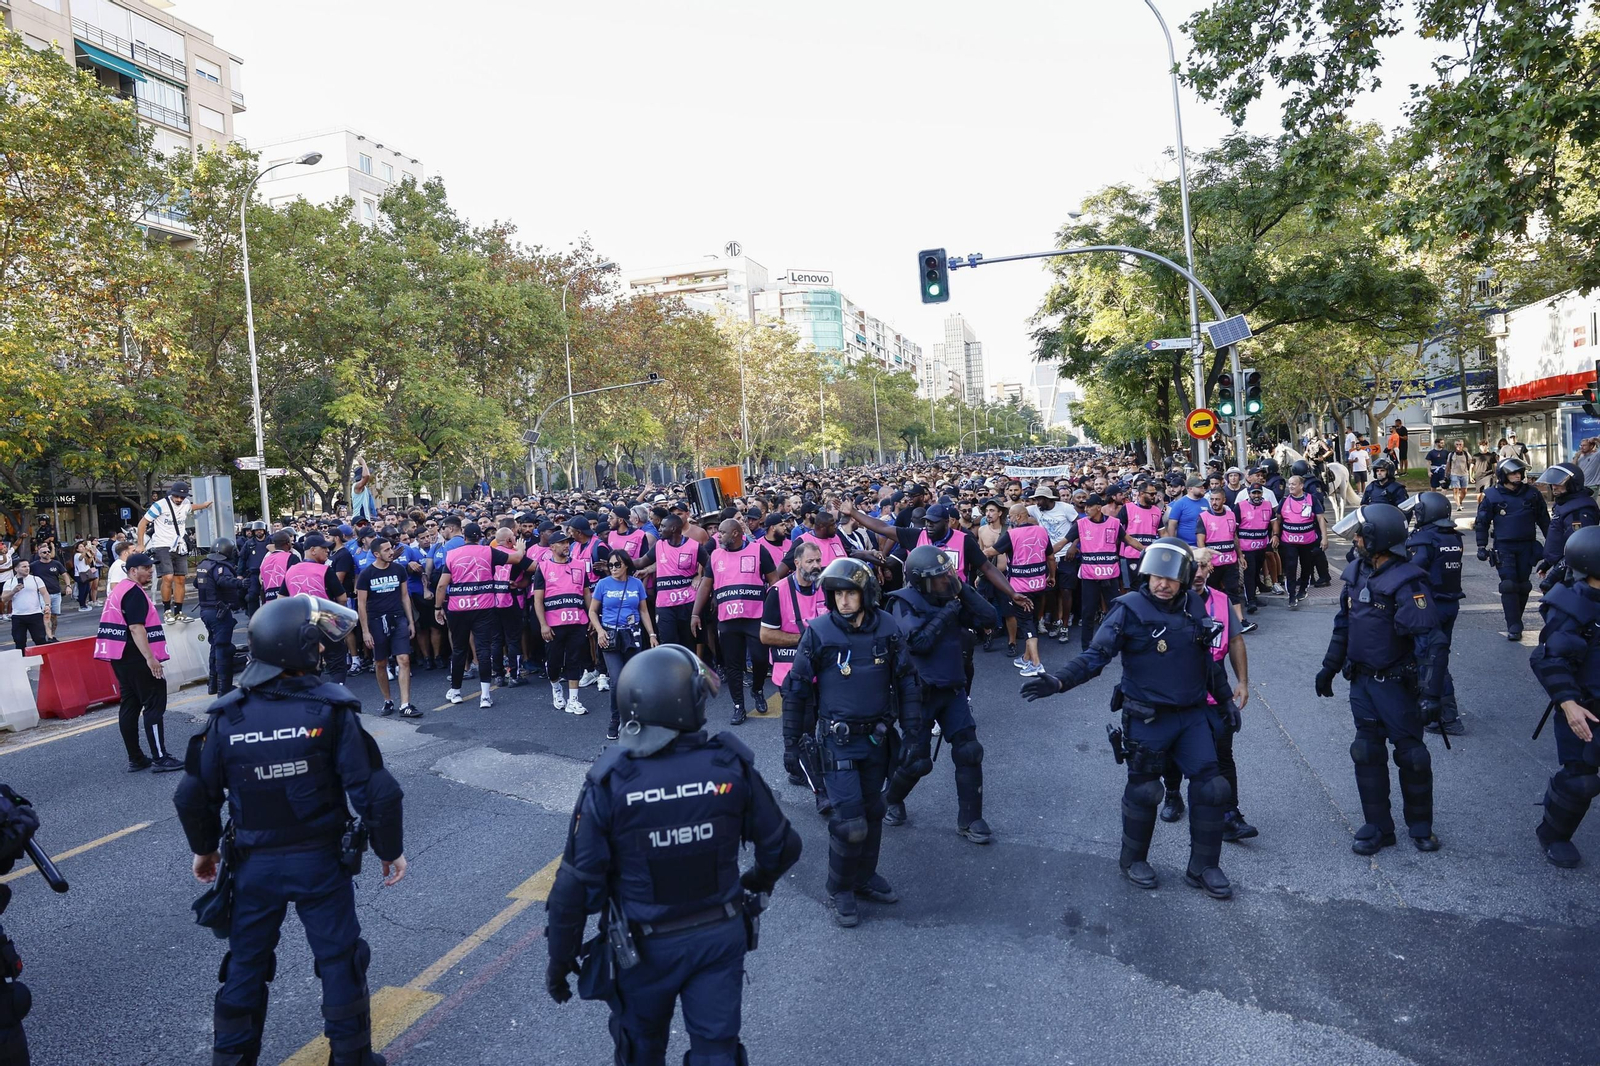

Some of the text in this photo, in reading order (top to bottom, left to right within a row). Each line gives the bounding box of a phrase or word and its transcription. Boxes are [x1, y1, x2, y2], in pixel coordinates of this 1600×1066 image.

[726, 242, 741, 257] MG
[791, 272, 830, 283] Lenovo
[122, 509, 129, 517] P
[1094, 566, 1114, 576] 010
[370, 575, 398, 586] ULTRAS
[1028, 578, 1045, 589] 022
[670, 590, 690, 603] 019
[739, 588, 761, 596] SUPPORT
[459, 597, 479, 608] 011
[726, 602, 744, 615] 023
[561, 610, 580, 622] 031
[229, 726, 309, 746] POLICIA
[254, 760, 309, 780] 1U233
[626, 780, 718, 806] POLICIA
[648, 822, 713, 848] 1U1810
